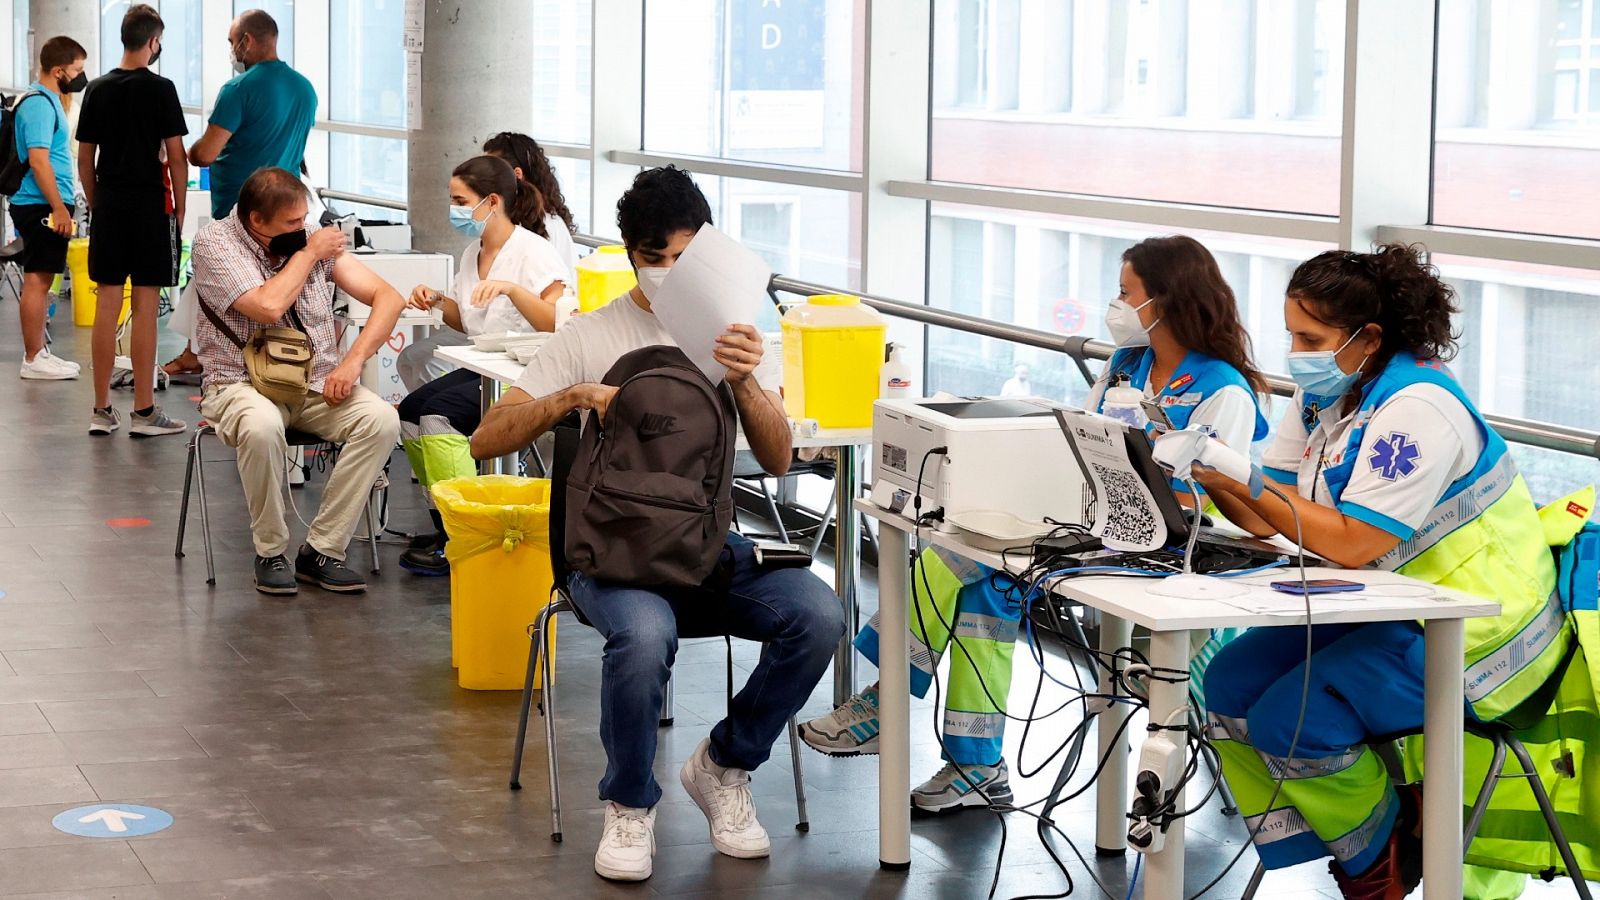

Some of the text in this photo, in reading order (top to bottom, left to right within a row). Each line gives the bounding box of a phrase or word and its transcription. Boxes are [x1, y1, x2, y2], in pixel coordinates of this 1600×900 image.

[640, 412, 677, 432] NIKE
[1414, 510, 1455, 540] SUMMA 112
[957, 621, 978, 630] UMMA
[1468, 659, 1508, 690] SUMMA 112
[1270, 820, 1283, 831] 112
